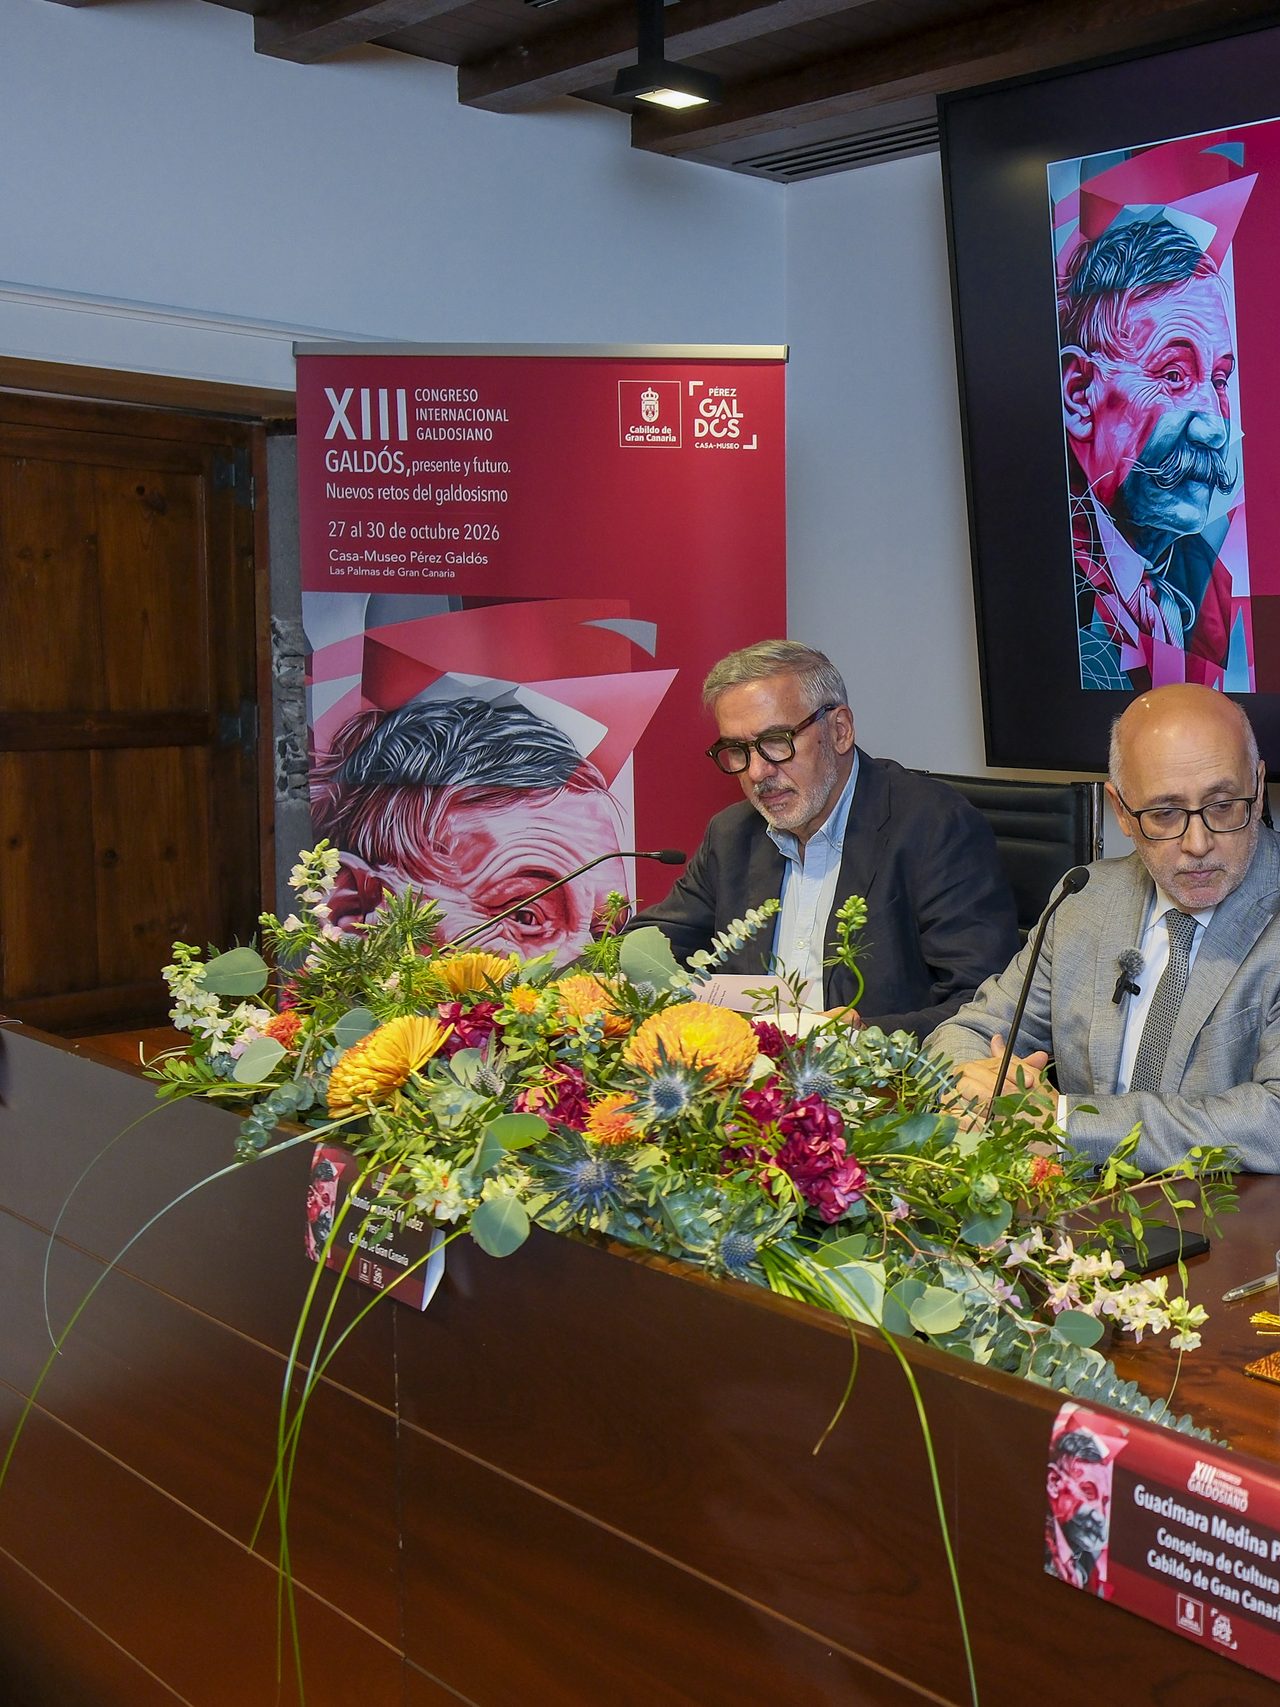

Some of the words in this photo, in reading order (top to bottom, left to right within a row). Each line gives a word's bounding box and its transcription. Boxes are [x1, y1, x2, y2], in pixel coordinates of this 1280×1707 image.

[708, 386, 737, 397] PÉREZ
[324, 387, 409, 441] XIII
[414, 388, 478, 402] CONGRESO
[415, 408, 509, 422] INTERNACIONAL
[699, 398, 744, 418] GAL
[416, 427, 493, 442] GALDOSIANO
[625, 434, 645, 442] Gran
[646, 434, 677, 442] Canaria
[629, 425, 660, 434] Cabildo
[661, 426, 672, 434] de
[694, 442, 740, 450] CASA-MUSEO
[412, 458, 461, 476] presente
[463, 461, 471, 477] y
[472, 456, 511, 473] futuro.
[326, 483, 374, 499] Nuevos
[377, 486, 410, 500] retos
[412, 484, 432, 501] del
[435, 484, 508, 506] galdosismo
[328, 521, 346, 537] 27
[350, 521, 362, 538] al
[366, 522, 385, 538] 30
[389, 522, 406, 539] de
[410, 522, 460, 540] octubre
[463, 523, 500, 541] 2026
[329, 549, 407, 563] Casa-Museo
[410, 551, 442, 564] Pérez
[445, 551, 488, 565] Galdós
[329, 566, 345, 575] Las
[347, 566, 381, 576] Palmas
[383, 567, 395, 577] de
[397, 567, 420, 577] Gran
[421, 567, 456, 578] Canaria
[1187, 1476, 1249, 1513] GALDOSIANO
[1133, 1484, 1209, 1533] Guacimara
[1211, 1515, 1269, 1558] Medina
[1157, 1527, 1215, 1566] Consejera
[1215, 1552, 1232, 1574] de
[1233, 1560, 1280, 1595] Cultura
[1147, 1549, 1192, 1583] Cabildo
[1192, 1568, 1209, 1591] de
[1210, 1576, 1240, 1604] Gran
